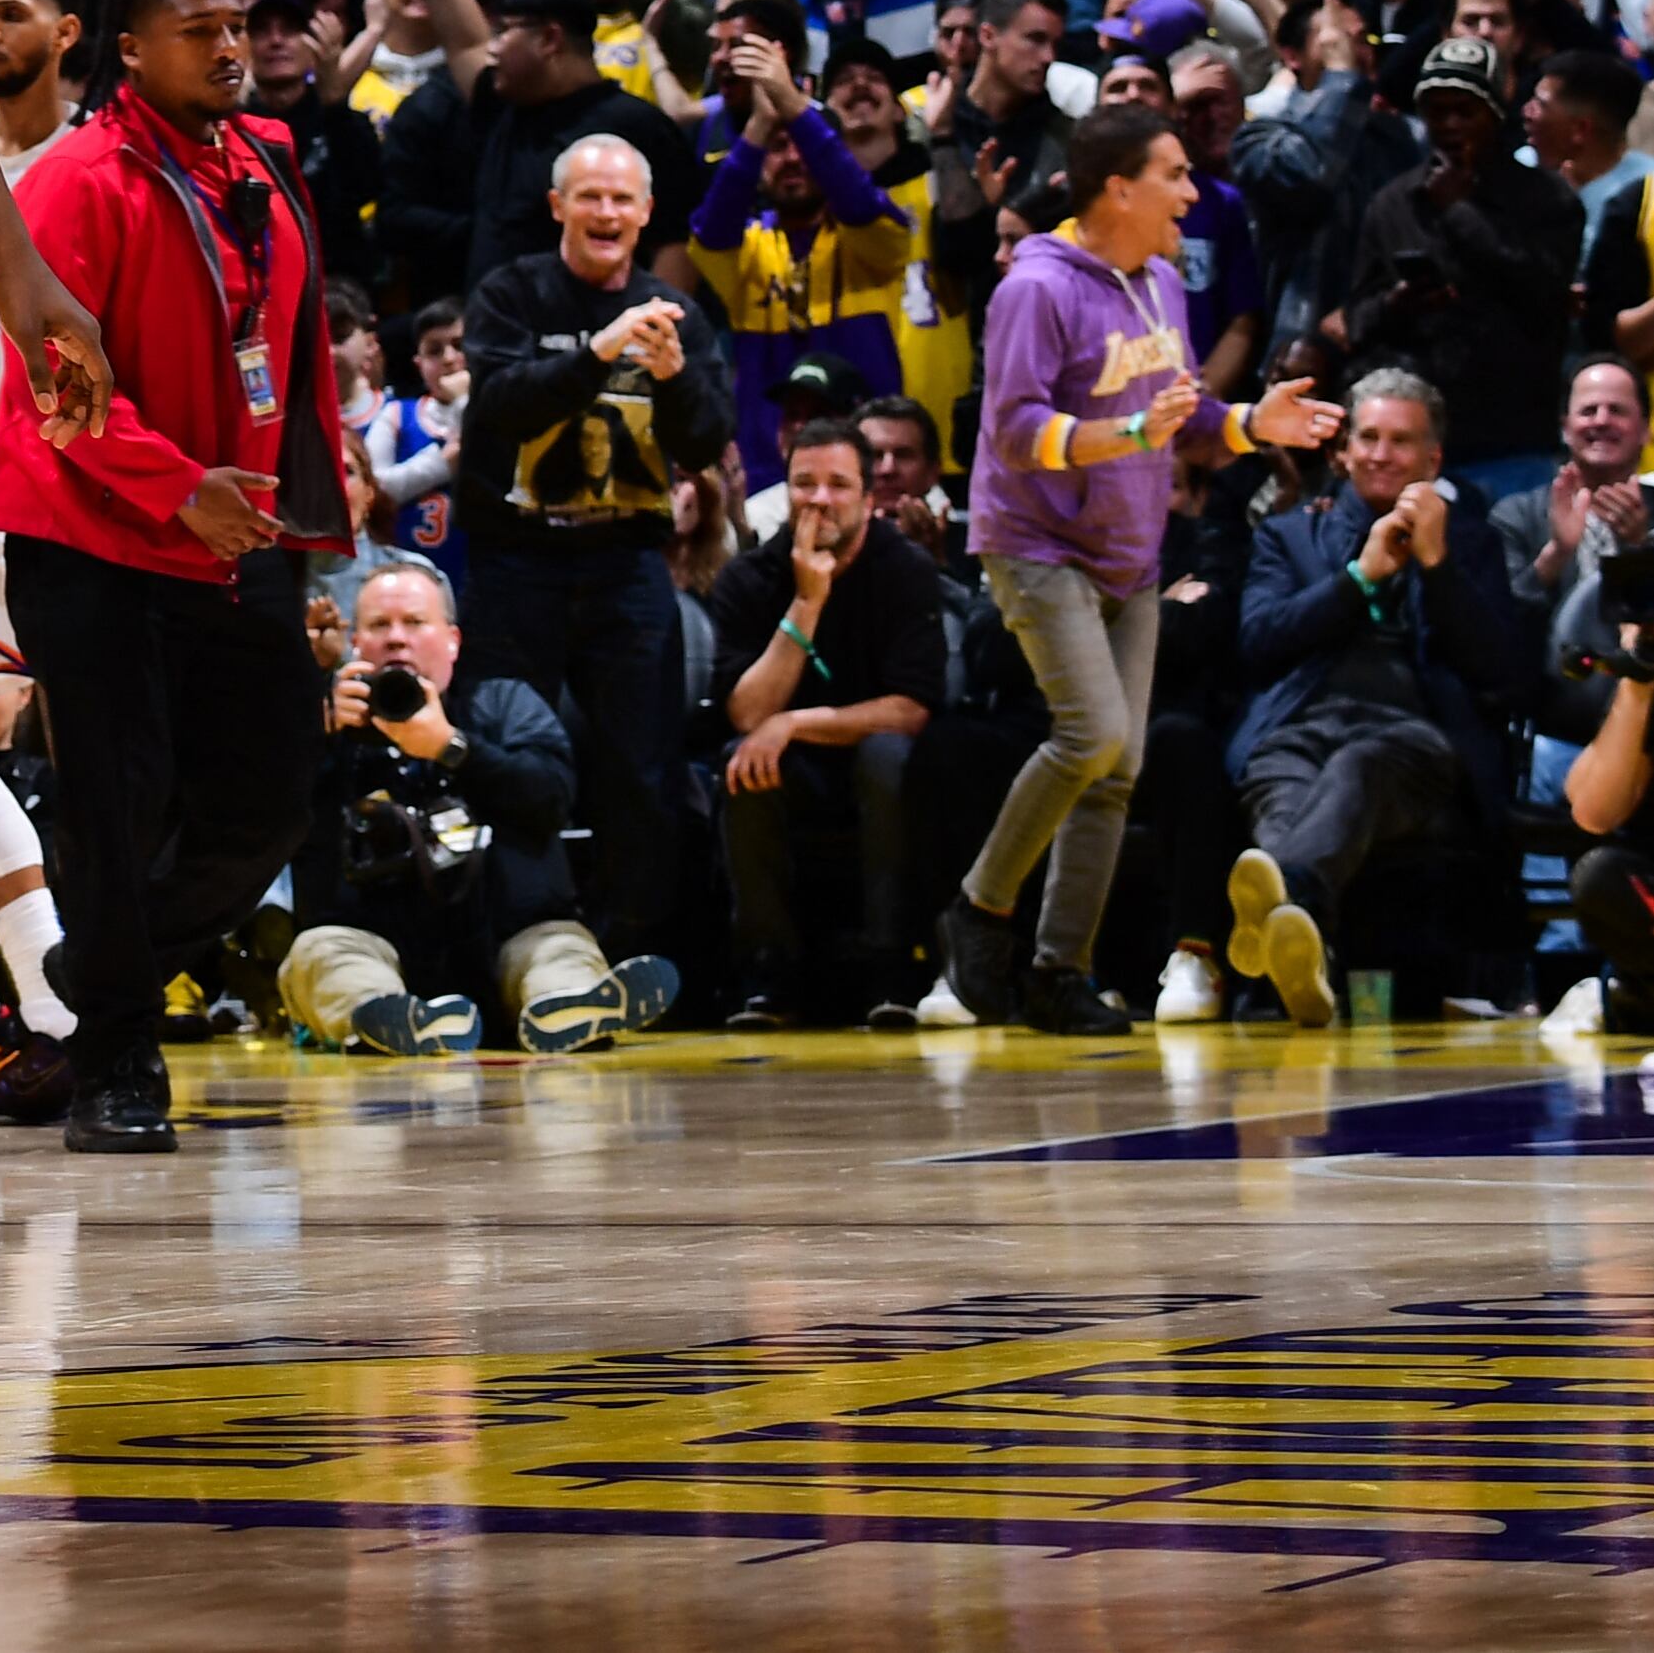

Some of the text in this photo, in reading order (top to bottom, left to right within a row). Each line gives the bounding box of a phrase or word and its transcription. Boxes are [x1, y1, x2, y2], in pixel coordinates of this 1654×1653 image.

[410, 492, 451, 549] 3
[31, 1291, 1262, 1469] LOS ANGELES
